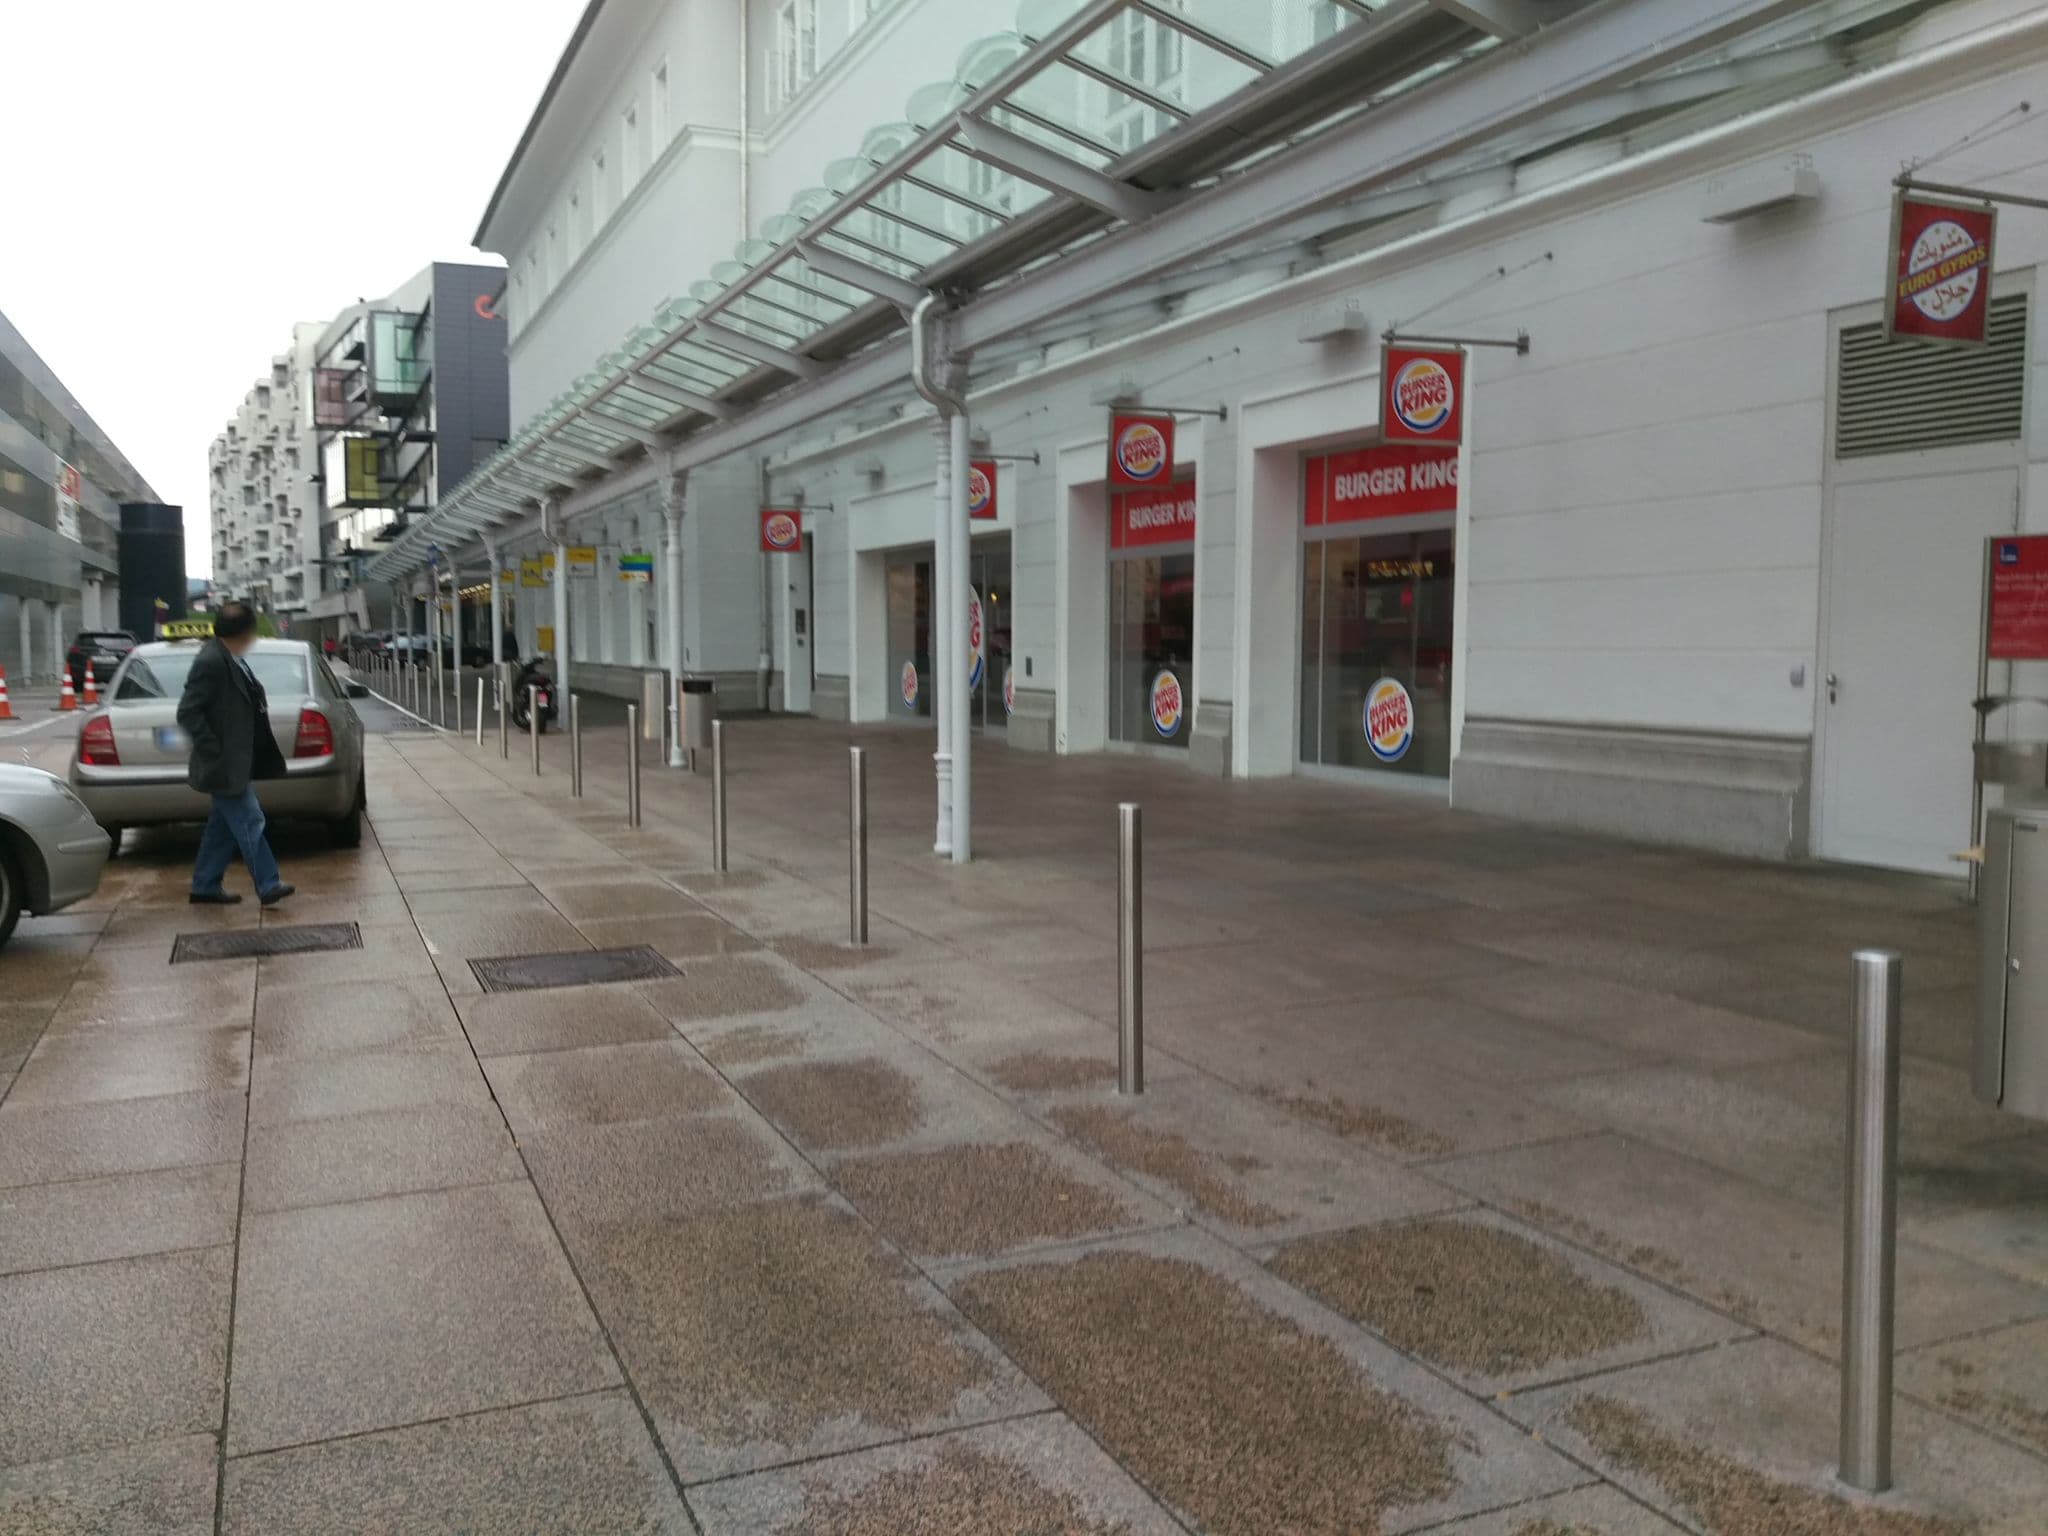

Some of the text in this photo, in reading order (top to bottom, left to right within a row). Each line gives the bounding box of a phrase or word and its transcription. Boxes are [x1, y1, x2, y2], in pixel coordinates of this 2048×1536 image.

[1898, 244, 1986, 297] EURO GYROS
[1399, 373, 1447, 397] BURGER
[1401, 387, 1448, 416] KING
[1334, 458, 1458, 502] BURGER KING
[1128, 499, 1196, 530] BURGER KIN
[1369, 694, 1406, 721] BURGER
[1371, 710, 1408, 742] KING
